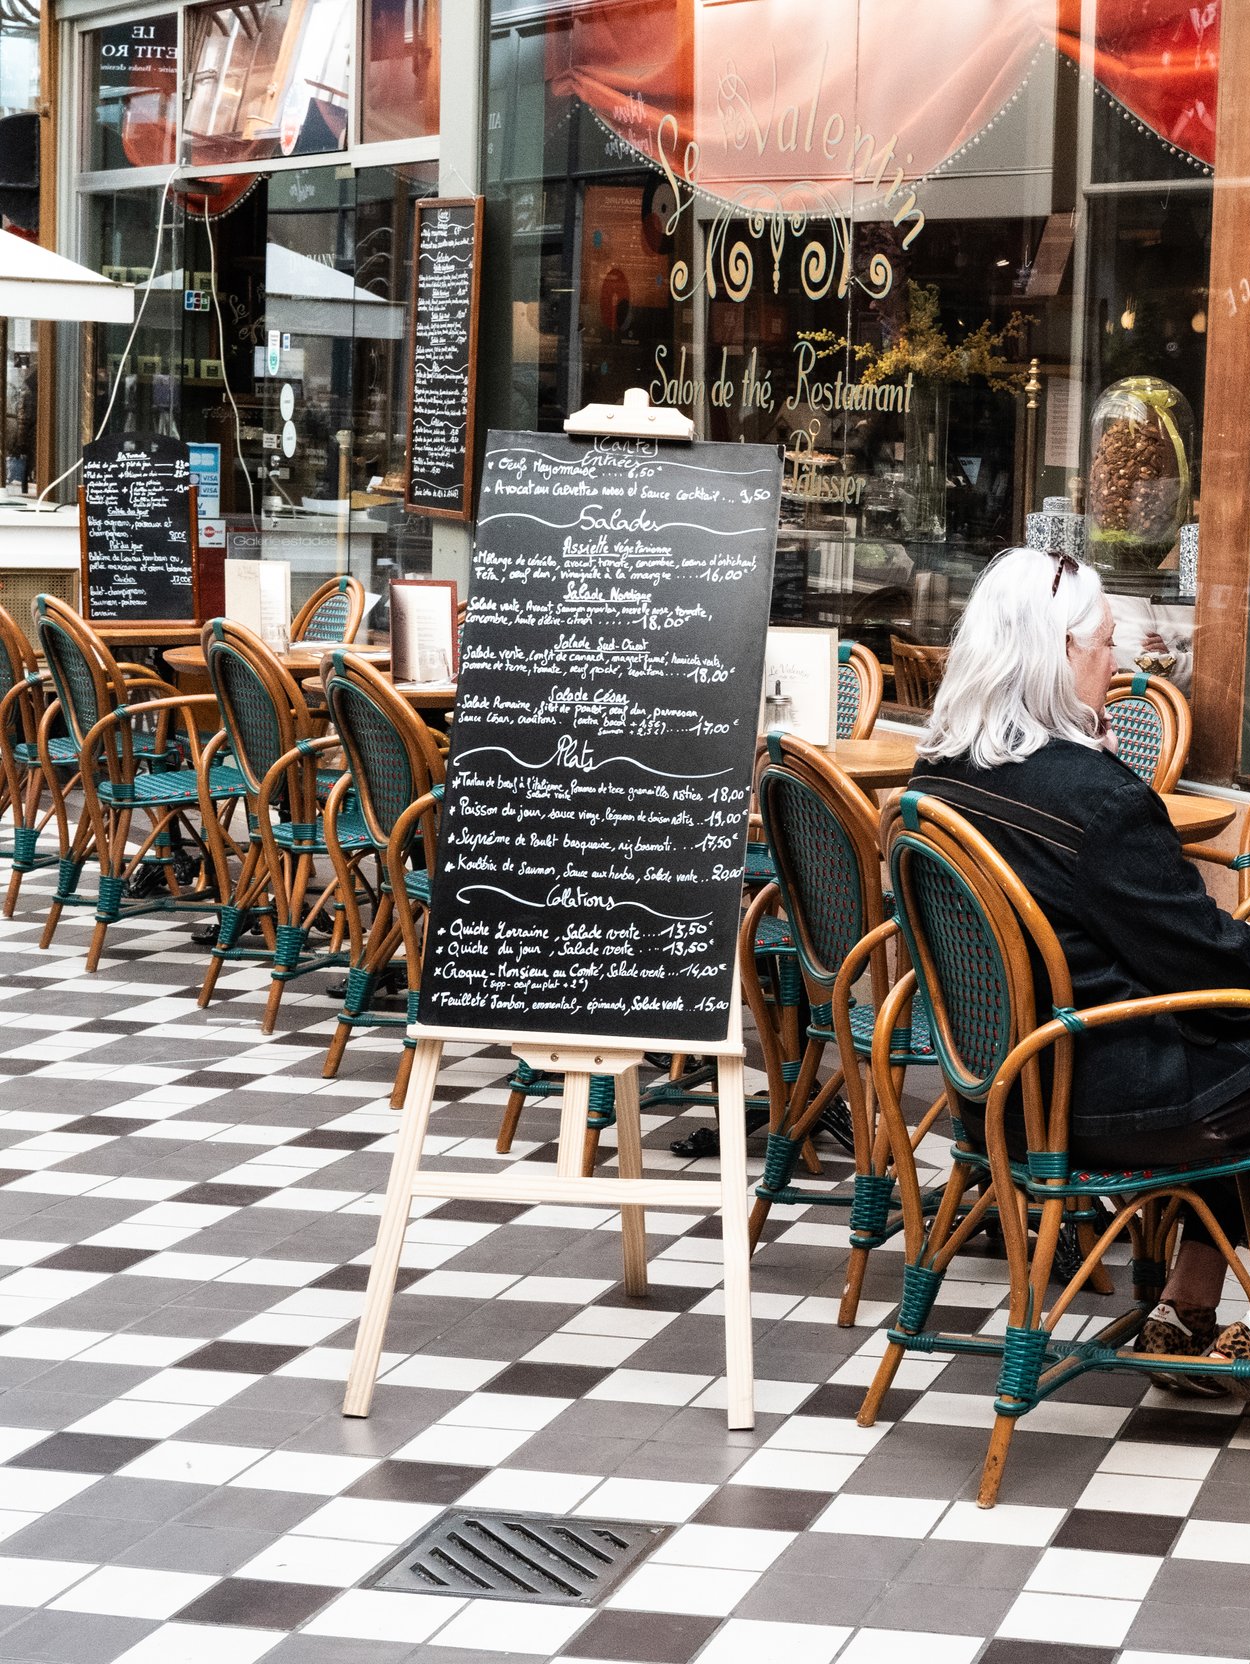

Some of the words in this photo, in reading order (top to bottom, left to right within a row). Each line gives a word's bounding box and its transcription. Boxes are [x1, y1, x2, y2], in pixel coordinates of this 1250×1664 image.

[657, 114, 700, 236] Le
[717, 41, 925, 251] Valentin
[650, 344, 707, 406] Salon
[711, 346, 735, 408] de
[787, 341, 914, 413] Restaurant
[600, 436, 653, 454] Carte
[533, 458, 599, 480] Mayonnaise
[788, 429, 867, 505] Pâtissier
[202, 486, 218, 494] VISA
[627, 482, 638, 496] et
[641, 485, 671, 500] Sauce
[580, 504, 660, 532] Salades
[563, 535, 609, 554] Assiette
[515, 553, 526, 566] de
[563, 581, 605, 601] Salade
[610, 586, 652, 605] Nordique
[554, 633, 590, 649] Salade
[462, 645, 497, 660] Salade
[461, 694, 489, 709] Salade
[548, 685, 588, 702] Salade
[556, 734, 594, 773] Plats
[460, 796, 498, 816] Poisson
[502, 802, 516, 817] du
[455, 826, 511, 852] Suprême
[515, 833, 526, 846] de
[530, 832, 559, 847] Poulet
[502, 857, 515, 871] de
[563, 861, 588, 878] Sauce
[546, 883, 615, 911] Collations
[449, 918, 490, 940] Quiche
[562, 923, 602, 941] Salade
[605, 922, 641, 940] verte
[447, 940, 489, 958] Quiche
[497, 940, 514, 956] du
[557, 941, 600, 957] Salade
[602, 940, 635, 957] verte
[553, 969, 567, 978] au
[606, 960, 638, 978] Salade
[440, 991, 489, 1008] Feuilleté
[631, 995, 661, 1011] Salade
